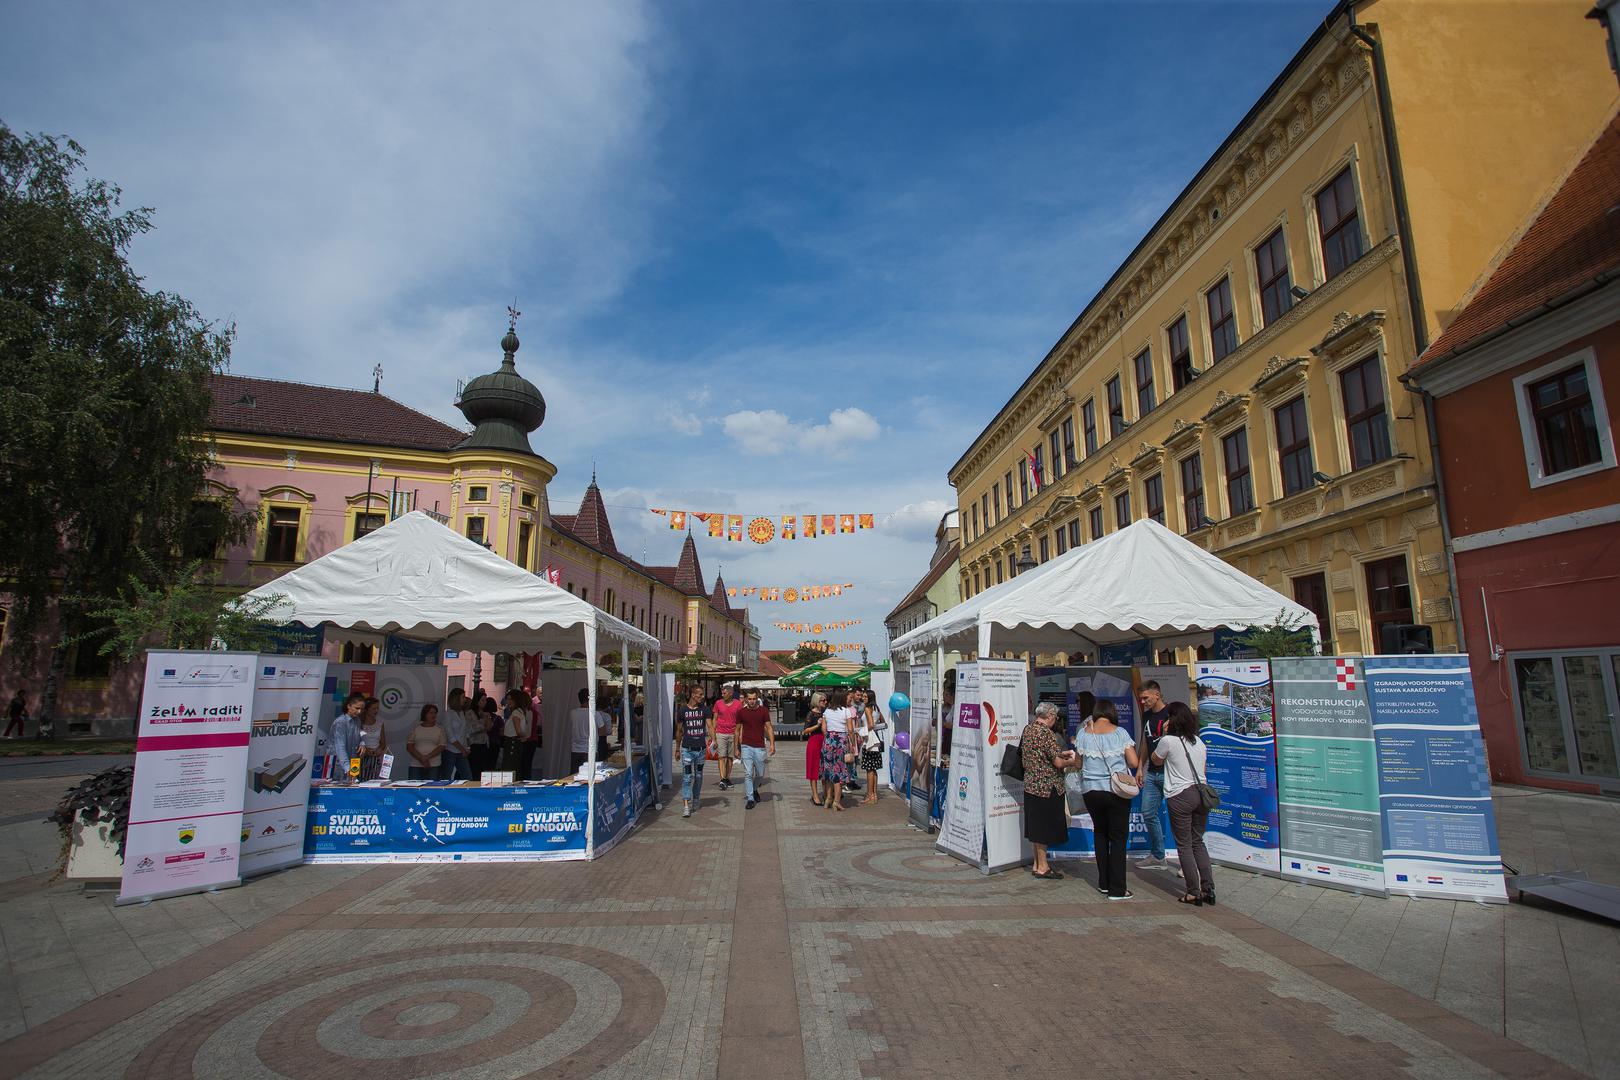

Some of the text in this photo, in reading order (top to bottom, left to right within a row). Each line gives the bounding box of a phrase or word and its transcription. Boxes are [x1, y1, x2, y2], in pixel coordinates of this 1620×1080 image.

[1281, 699, 1365, 708] REKONSTRUKCIJA
[203, 705, 242, 715] raditi
[251, 725, 313, 737] INKUBATOR
[329, 815, 380, 825] SVIJETA
[526, 812, 576, 823] SVIJETA
[312, 825, 386, 835] EU FONDOVA!
[436, 823, 456, 836] EU
[508, 822, 582, 833] EU FONDOVA!
[1241, 822, 1269, 830] IVANKOVO
